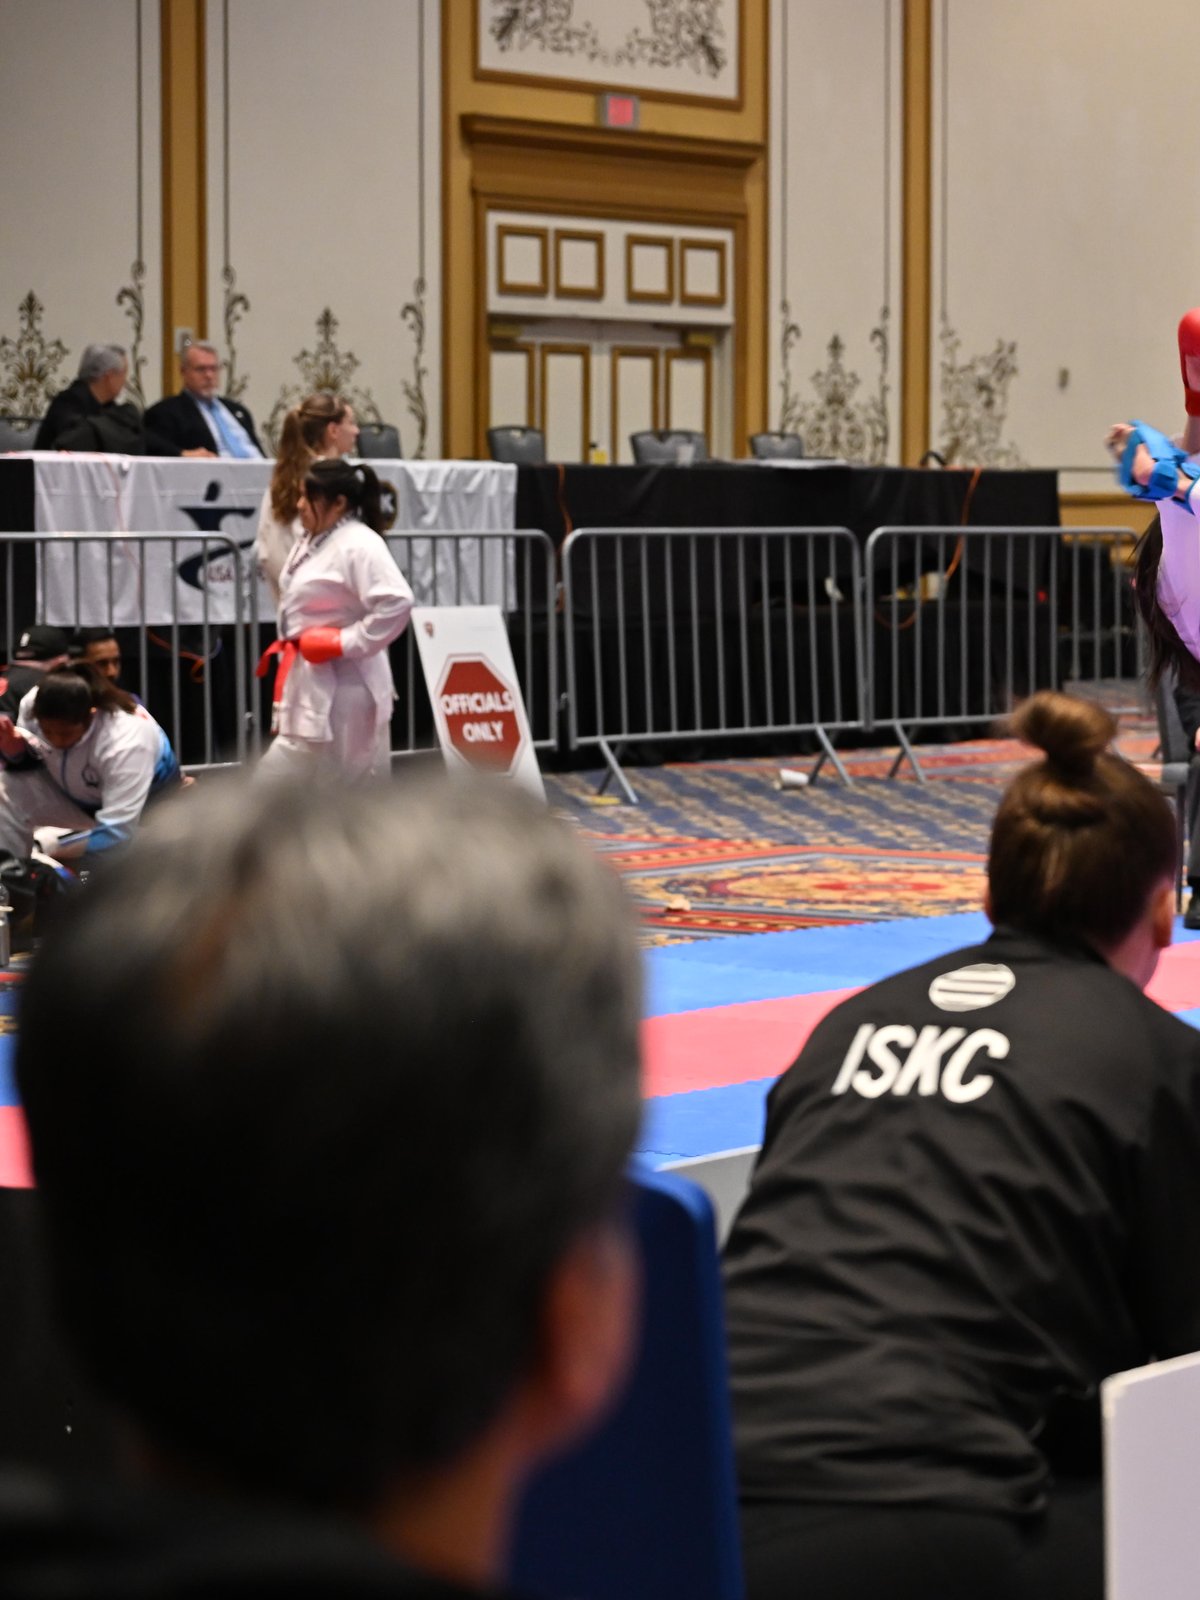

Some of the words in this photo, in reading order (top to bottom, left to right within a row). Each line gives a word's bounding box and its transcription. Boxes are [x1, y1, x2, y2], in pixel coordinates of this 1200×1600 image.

[440, 691, 514, 715] OFFICIALS
[463, 720, 504, 743] ONLY
[831, 1023, 1010, 1104] ISKC
